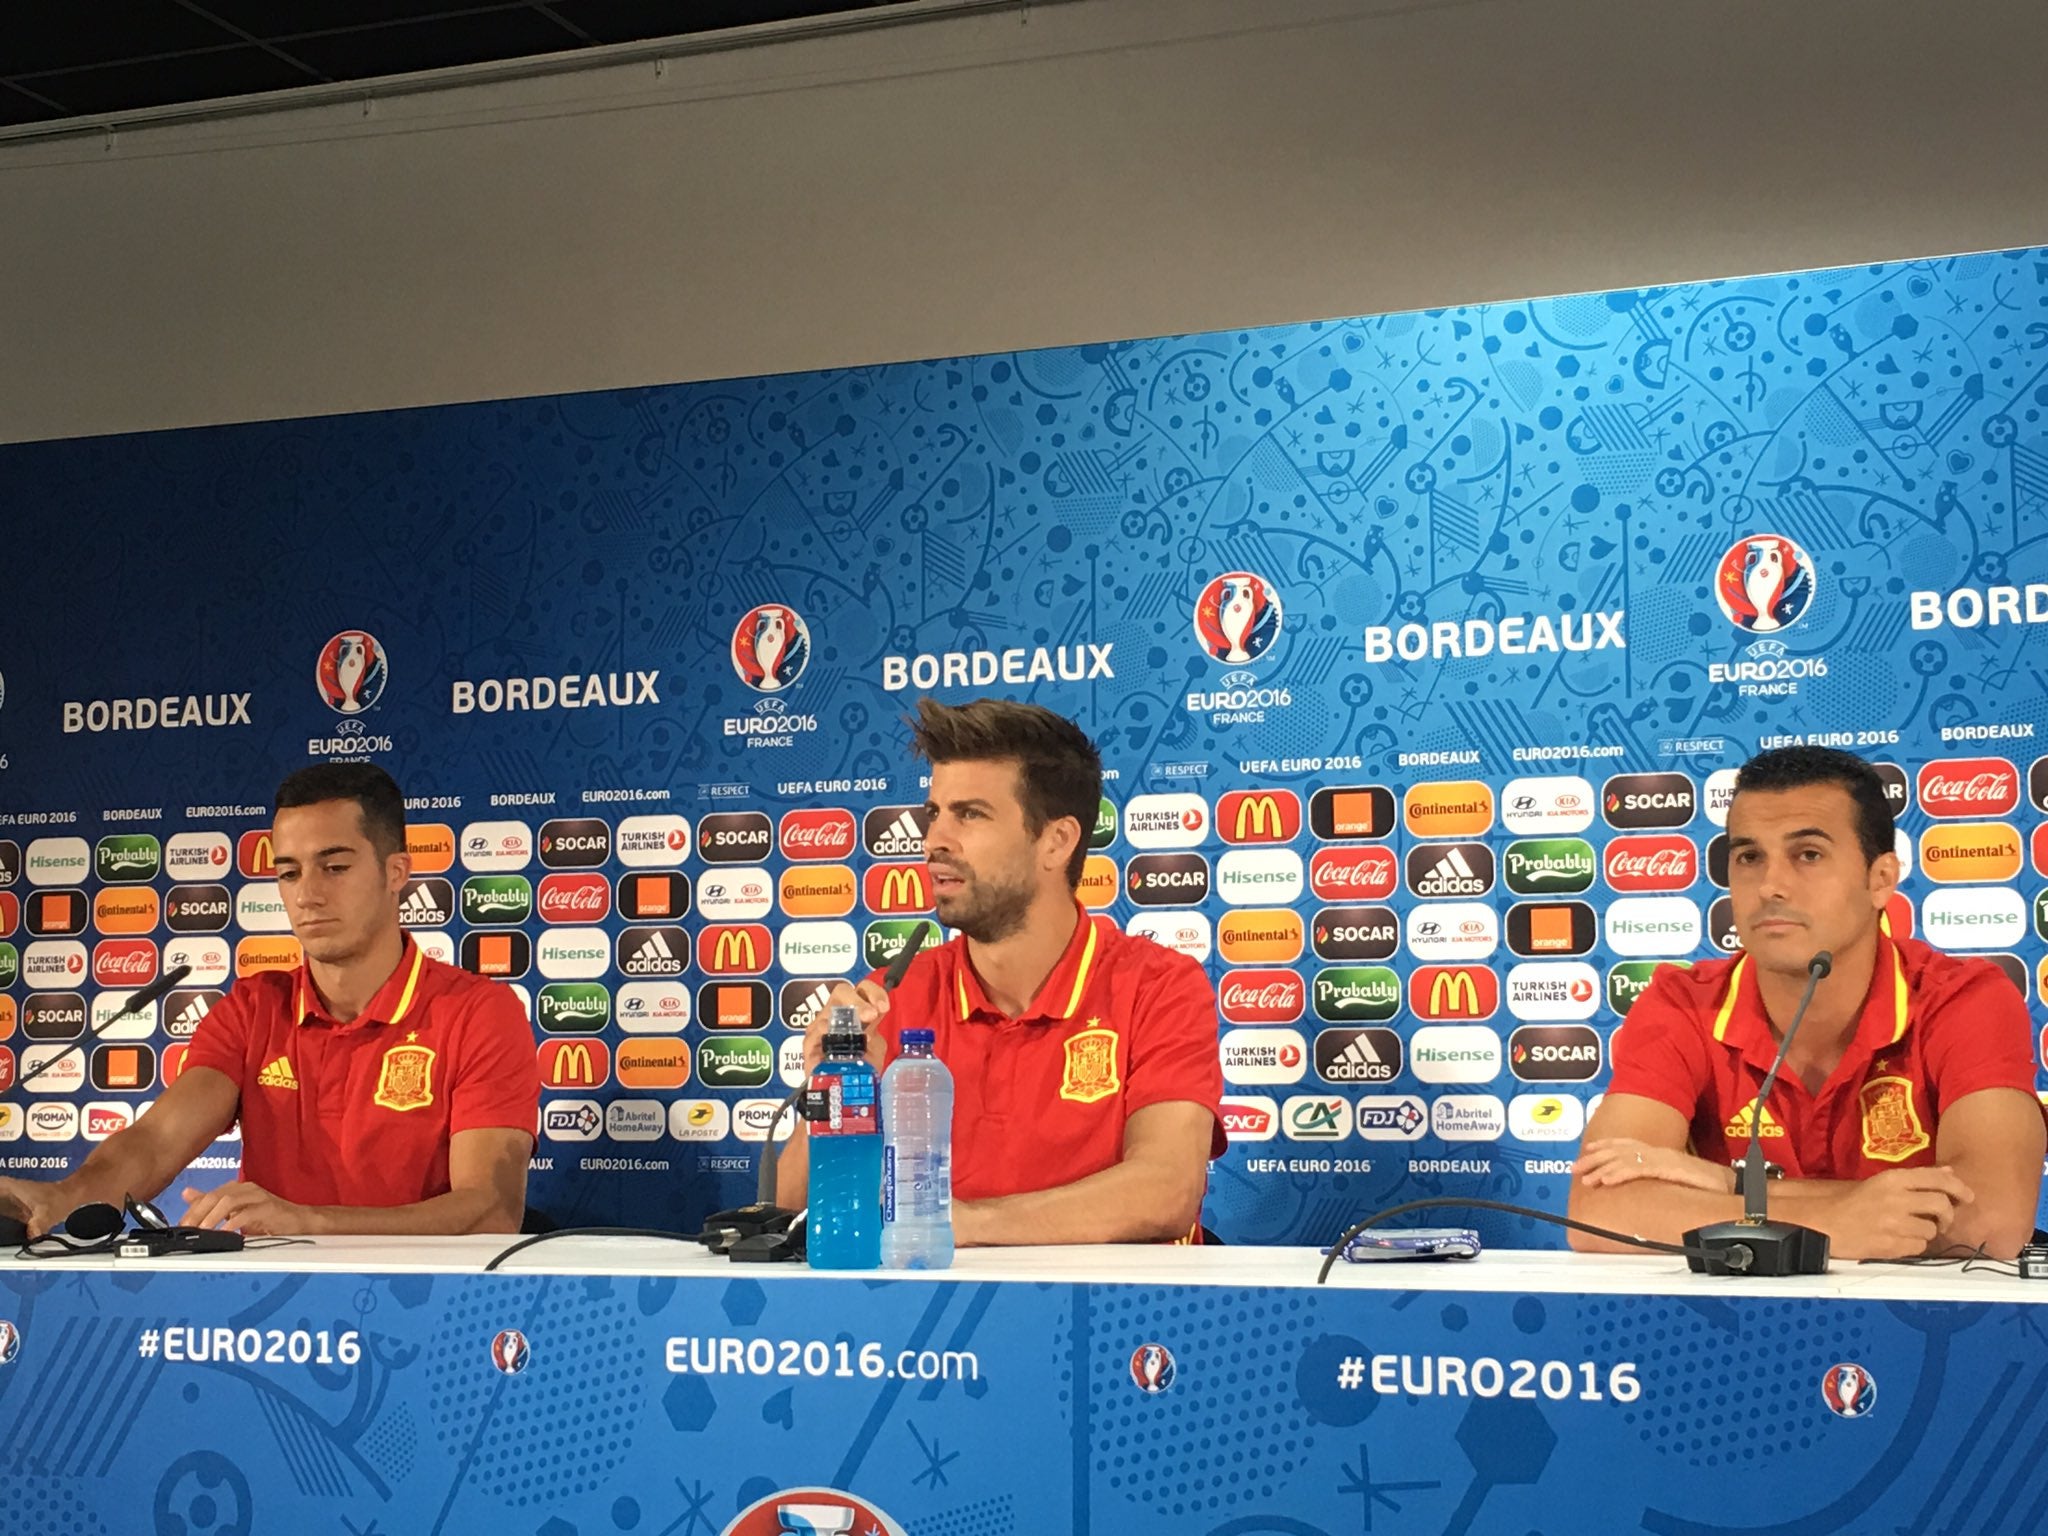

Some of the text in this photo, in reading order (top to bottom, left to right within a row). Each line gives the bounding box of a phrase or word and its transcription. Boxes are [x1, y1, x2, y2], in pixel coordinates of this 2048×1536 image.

[1910, 584, 2048, 630] BORD
[1364, 611, 1626, 662] BORDEAUX
[1746, 640, 1788, 659] UEFA
[884, 644, 1114, 690] BORDEAUX
[1709, 658, 1827, 682] EURO2016
[1221, 672, 1257, 687] UEFA
[452, 671, 660, 713] BORDEAUX
[1739, 682, 1798, 696] FRANCE
[1187, 688, 1291, 711] EURO2016
[63, 693, 251, 733] BORDEAUX
[754, 700, 788, 715] UEFA
[724, 714, 817, 735] EURO2016
[1213, 711, 1265, 725] FRANCE
[337, 719, 365, 735] UEFA
[1941, 724, 2034, 740] BORDEAUX
[308, 735, 393, 755] EURO2016
[747, 735, 793, 748] FRANCE
[1676, 740, 1724, 751] RESPECT
[1760, 730, 1899, 748] UEFA EURO 2016
[1399, 751, 1479, 766] BORDEAUX
[1513, 745, 1624, 761] EURO2016.com
[1166, 765, 1207, 775] RESPECT
[1240, 757, 1361, 773] UEFA EURO 2016
[711, 785, 749, 796] RESPECT
[778, 779, 886, 794] UEFA EURO 2016
[1923, 773, 2011, 803] Coca-Cola
[491, 793, 556, 806] BORDEAUX
[583, 790, 670, 802] EURO2016.com
[1624, 793, 1690, 809] SOCAR
[404, 797, 461, 810] URO 2016
[1409, 802, 1477, 818] Continental
[18, 811, 77, 824] EURO 2016
[103, 809, 162, 820] BORDEAUX
[186, 806, 266, 817] EURO2016.com
[1130, 812, 1179, 822] TURKISH
[1130, 822, 1179, 831] AIRLINES
[1335, 823, 1368, 832] orange
[621, 833, 665, 841] TURKISH
[715, 831, 768, 845] SOCAR
[784, 822, 850, 846] Coca-Cola
[556, 837, 606, 851] SOCAR
[621, 842, 665, 851] AIRLINES
[100, 847, 158, 865] Probably
[170, 848, 209, 856] TURKISH
[1926, 844, 2003, 862] Continental
[30, 856, 85, 868] Hisense
[170, 856, 209, 865] AIRLINES
[1508, 854, 1591, 874] Probably
[1609, 849, 1690, 878] Coca-Cola
[1223, 871, 1296, 884] Hisense
[1315, 859, 1391, 886] Coca-Cola
[1146, 873, 1204, 887] SOCAR
[1418, 877, 1484, 895] adidas
[464, 888, 528, 906] Probably
[542, 886, 603, 910] Coca-Cola
[784, 884, 842, 899] Continental
[97, 904, 147, 918] Continental
[181, 902, 227, 915] SOCAR
[241, 901, 286, 913] Hisens
[639, 904, 667, 913] orange
[1930, 912, 2018, 925] Hisense
[1613, 920, 1693, 933] Hisense
[1223, 930, 1288, 944] Continental
[1333, 926, 1394, 942] SOCAR
[785, 942, 851, 955] Hisense
[1533, 939, 1568, 947] orange
[27, 956, 65, 965] TURKISH
[239, 953, 291, 964] Continental
[542, 948, 604, 960] Hisense
[27, 965, 65, 974] AIRLINES
[96, 951, 153, 974] Coca-Cola
[481, 964, 507, 972] orange
[626, 957, 681, 974] adidas
[1318, 981, 1397, 1002] Probably
[1513, 982, 1567, 991] TURKISH
[1224, 983, 1298, 1009] Coca-Cola
[1513, 992, 1567, 1001] AIRLINES
[541, 995, 607, 1015] Probably
[38, 1010, 82, 1022] SOCAR
[720, 1015, 748, 1023] orange
[1225, 1047, 1276, 1056] TURKISH
[1416, 1048, 1494, 1062] Hisense
[1531, 1046, 1596, 1061] SOCAR
[620, 1057, 676, 1070] Continental
[702, 1049, 770, 1069] Probably
[1225, 1057, 1276, 1066] AIRLINES
[1326, 1062, 1390, 1079] adidas
[258, 1074, 298, 1090] adidas
[32, 1113, 73, 1122] PROMAN
[550, 1114, 576, 1126] FDJ
[626, 1112, 656, 1121] Abritel
[1363, 1111, 1395, 1125] FDJ
[1456, 1109, 1492, 1118] Abritel
[90, 1118, 125, 1131] SNCF
[610, 1123, 663, 1134] HomeAway
[1224, 1115, 1266, 1129] SNCF
[1436, 1122, 1501, 1133] HomeAway
[8, 1158, 38, 1168] EURO
[41, 1157, 68, 1168] 2016
[580, 1158, 669, 1170] EURO2016.com
[711, 1160, 750, 1169] RESPECT
[1247, 1160, 1371, 1172] UEFA EURO 2016
[1409, 1160, 1490, 1172] BORDEAUX
[139, 1327, 361, 1365] #EURO2016
[665, 1336, 978, 1381] EURO2016.com
[1337, 1354, 1641, 1402] #EURO2016
